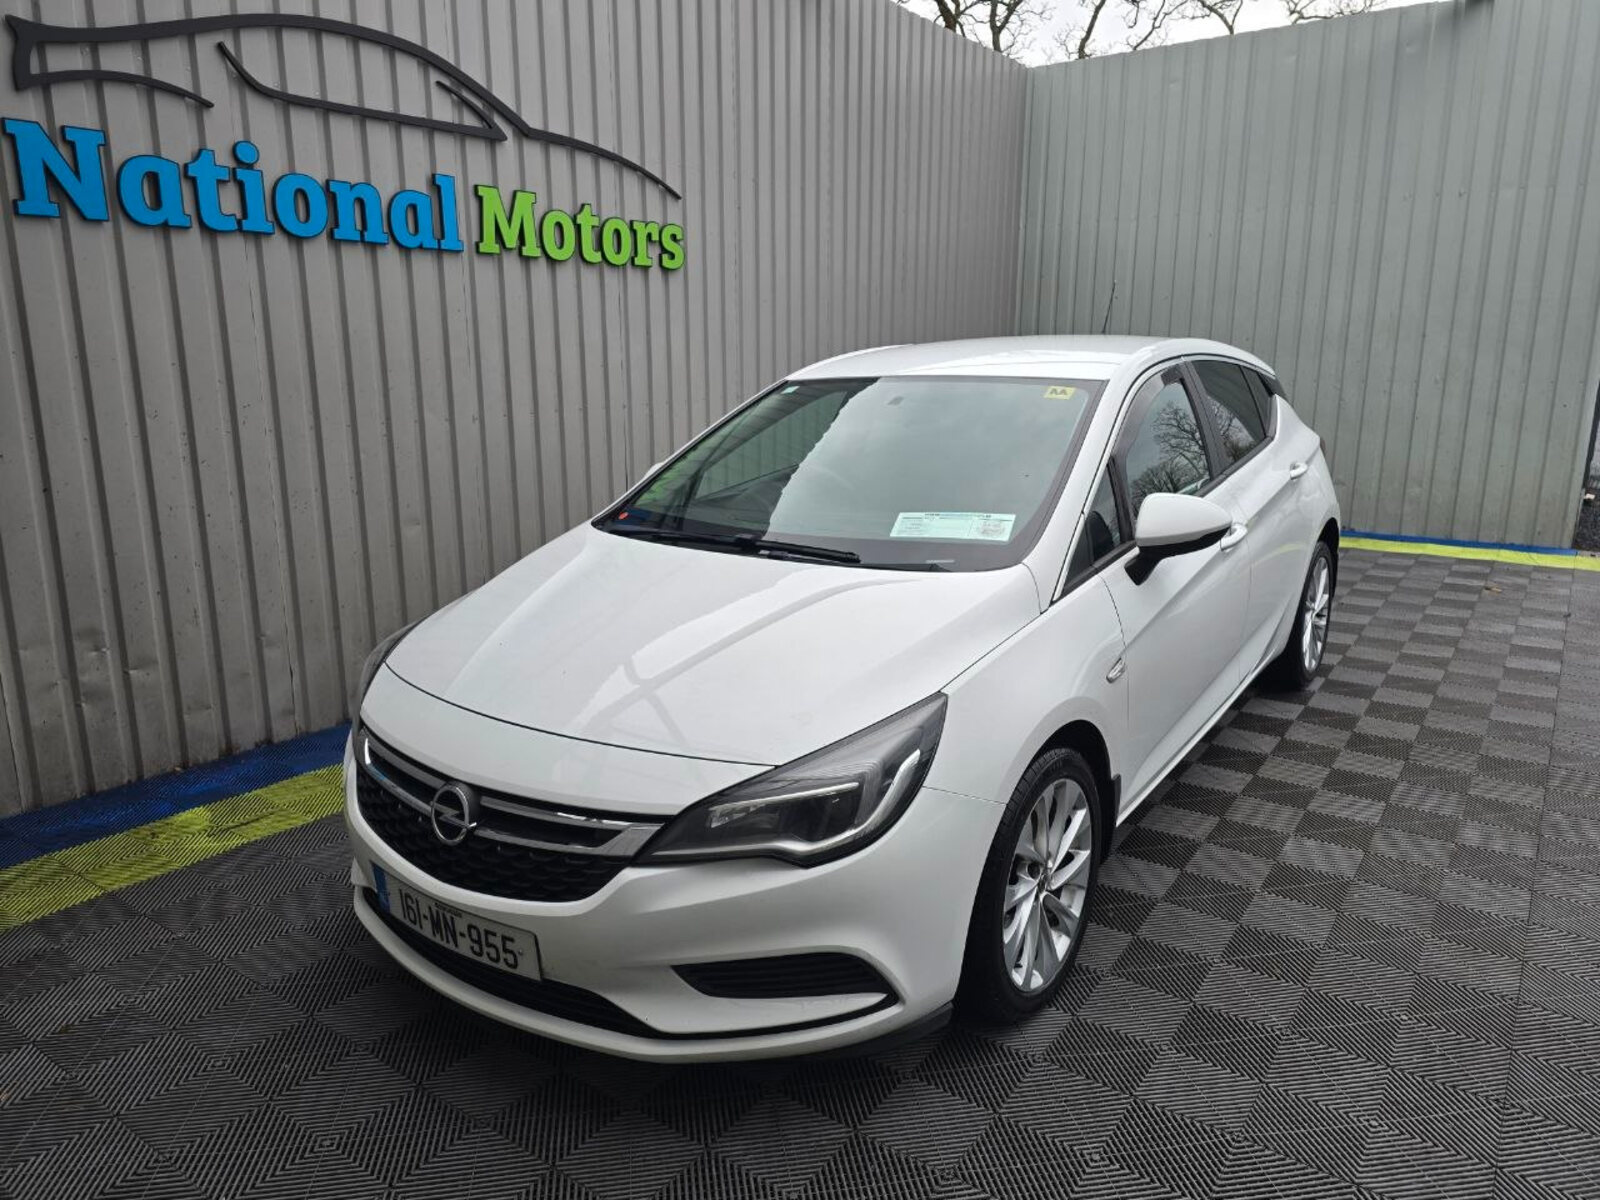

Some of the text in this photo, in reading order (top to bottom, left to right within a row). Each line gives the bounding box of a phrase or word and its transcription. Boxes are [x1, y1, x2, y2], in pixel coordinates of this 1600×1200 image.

[3, 117, 685, 270] National Motors
[398, 888, 519, 969] 161-MN-955
